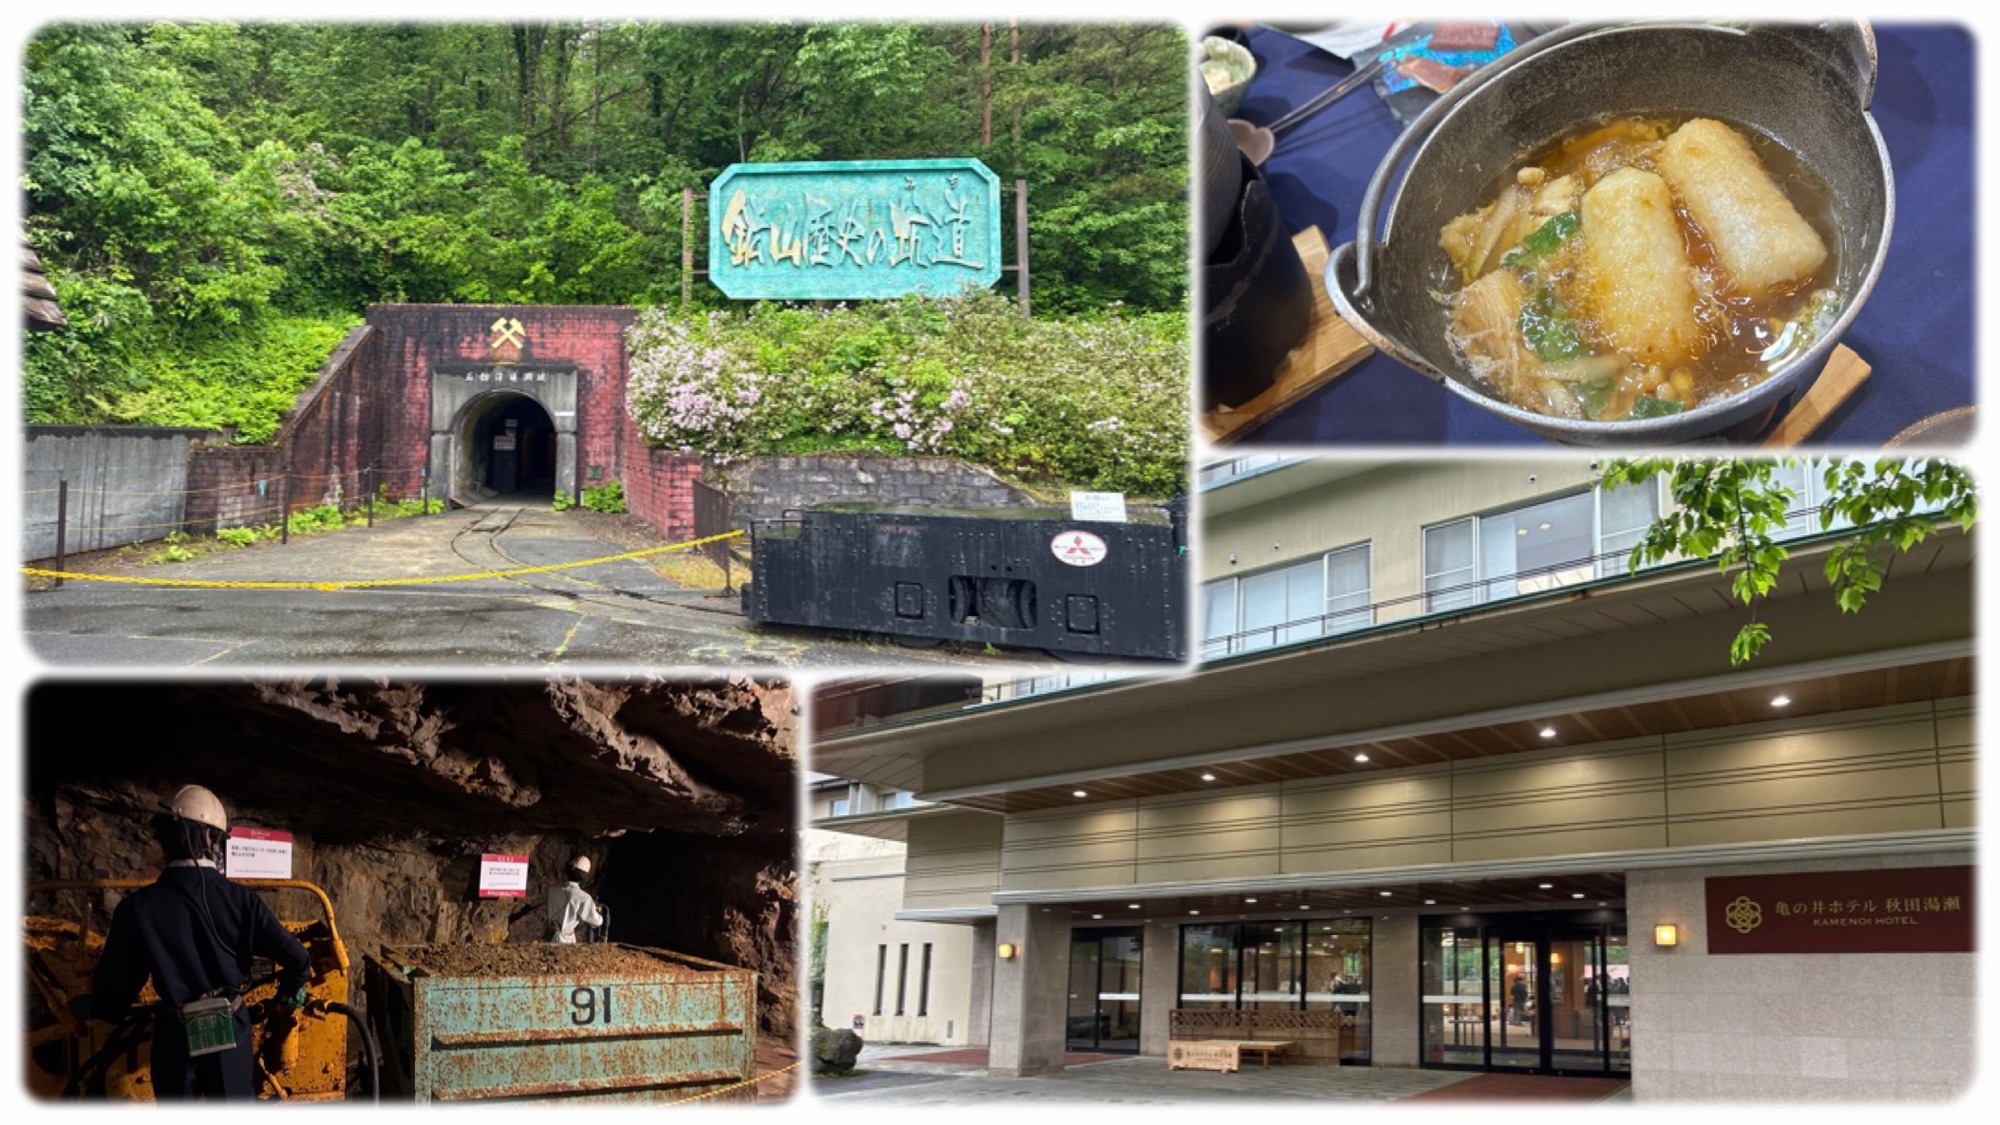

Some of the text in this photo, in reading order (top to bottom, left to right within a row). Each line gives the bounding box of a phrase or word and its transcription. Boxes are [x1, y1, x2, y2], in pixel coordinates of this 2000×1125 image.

[1775, 896, 1961, 916] 亀の井ホテル 秋田湯瀬
[1813, 916, 1918, 927] KAMENOI HOTEL
[570, 987, 611, 1025] 91
